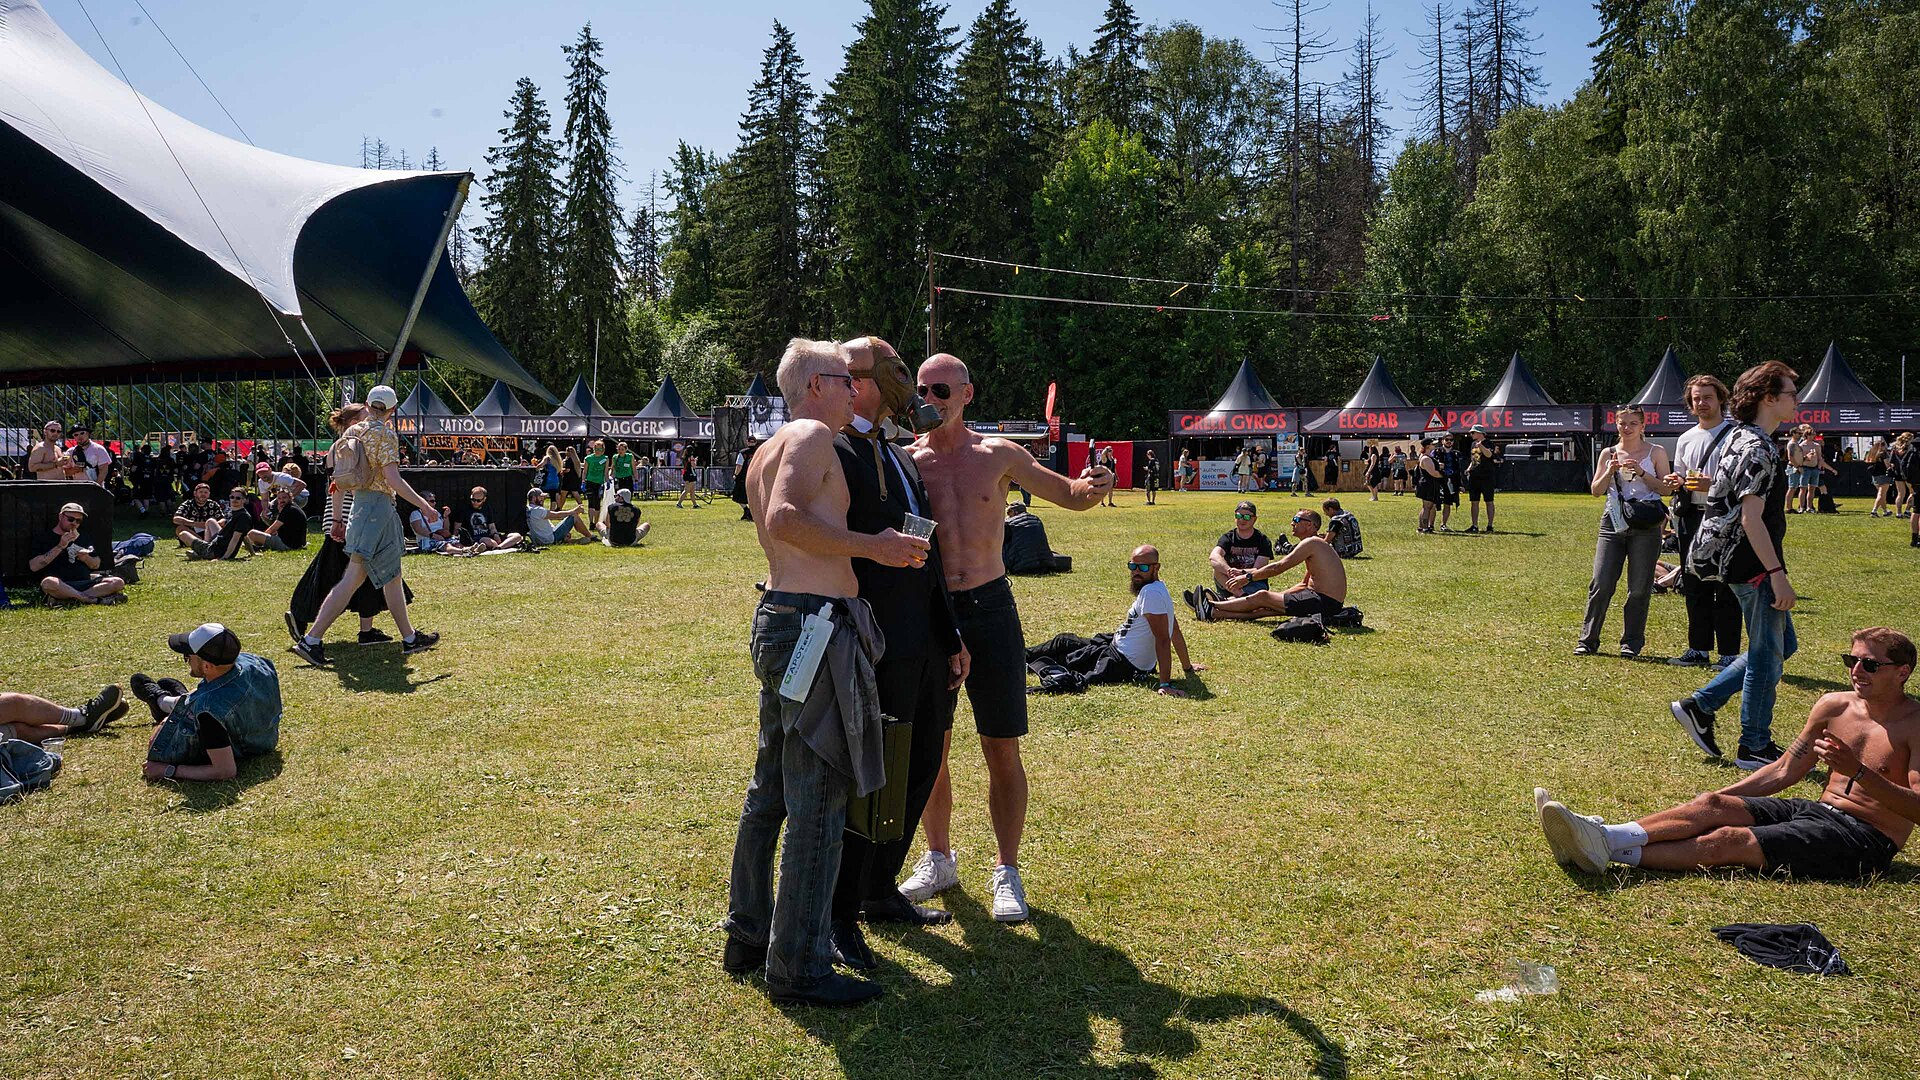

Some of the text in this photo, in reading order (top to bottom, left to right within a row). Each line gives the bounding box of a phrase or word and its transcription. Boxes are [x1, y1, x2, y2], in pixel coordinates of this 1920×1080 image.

[440, 418, 485, 432] TATTOO
[1181, 413, 1287, 430] GREEK GYROS
[1339, 412, 1398, 428] ELGBAB
[1446, 410, 1513, 428] PØLSE
[1606, 411, 1660, 425] BER
[520, 419, 569, 433] TATTOO
[601, 420, 664, 435] DAGGERS
